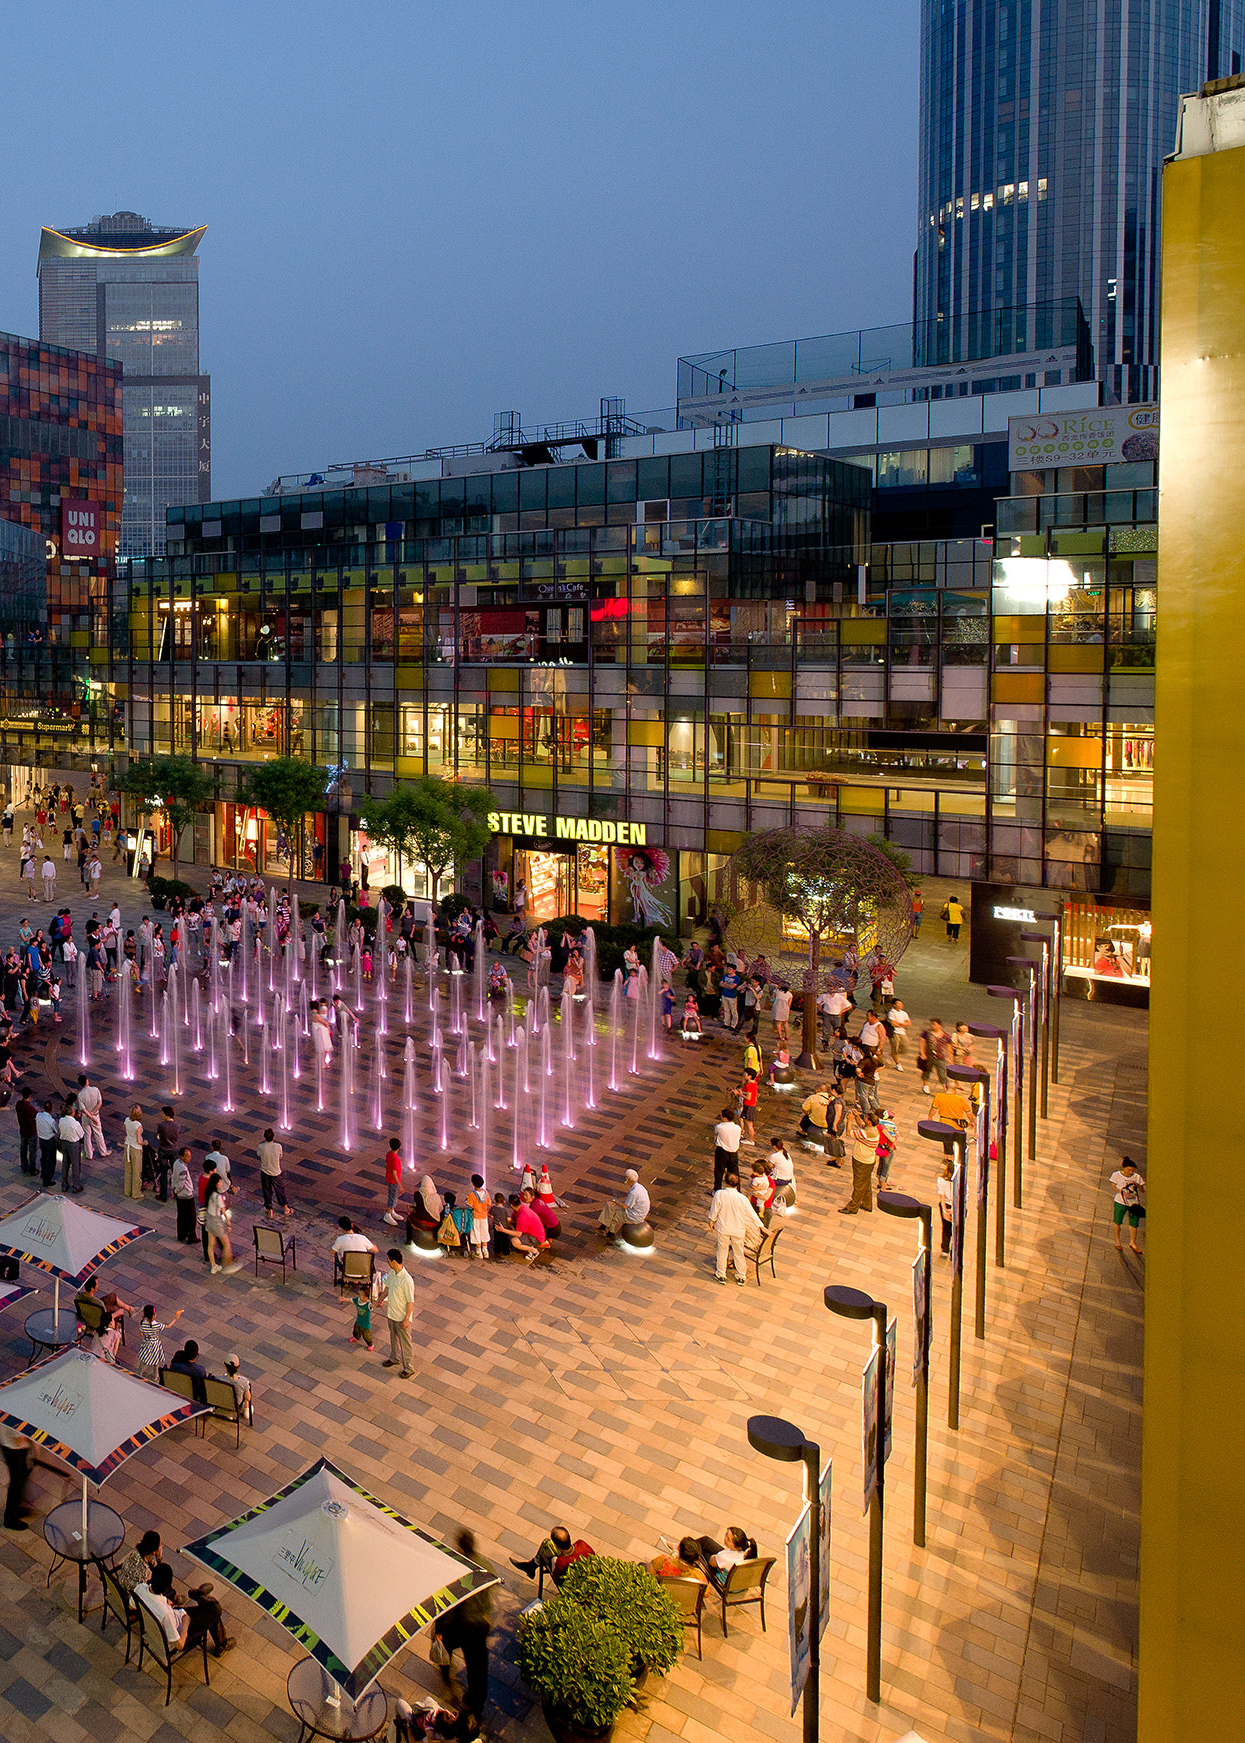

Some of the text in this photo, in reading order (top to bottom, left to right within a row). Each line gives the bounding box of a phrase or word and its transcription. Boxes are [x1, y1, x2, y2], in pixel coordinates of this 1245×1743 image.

[68, 510, 95, 527] UNI
[67, 529, 95, 545] QLO
[487, 812, 548, 837] STEVE
[556, 817, 647, 846] MADDEN
